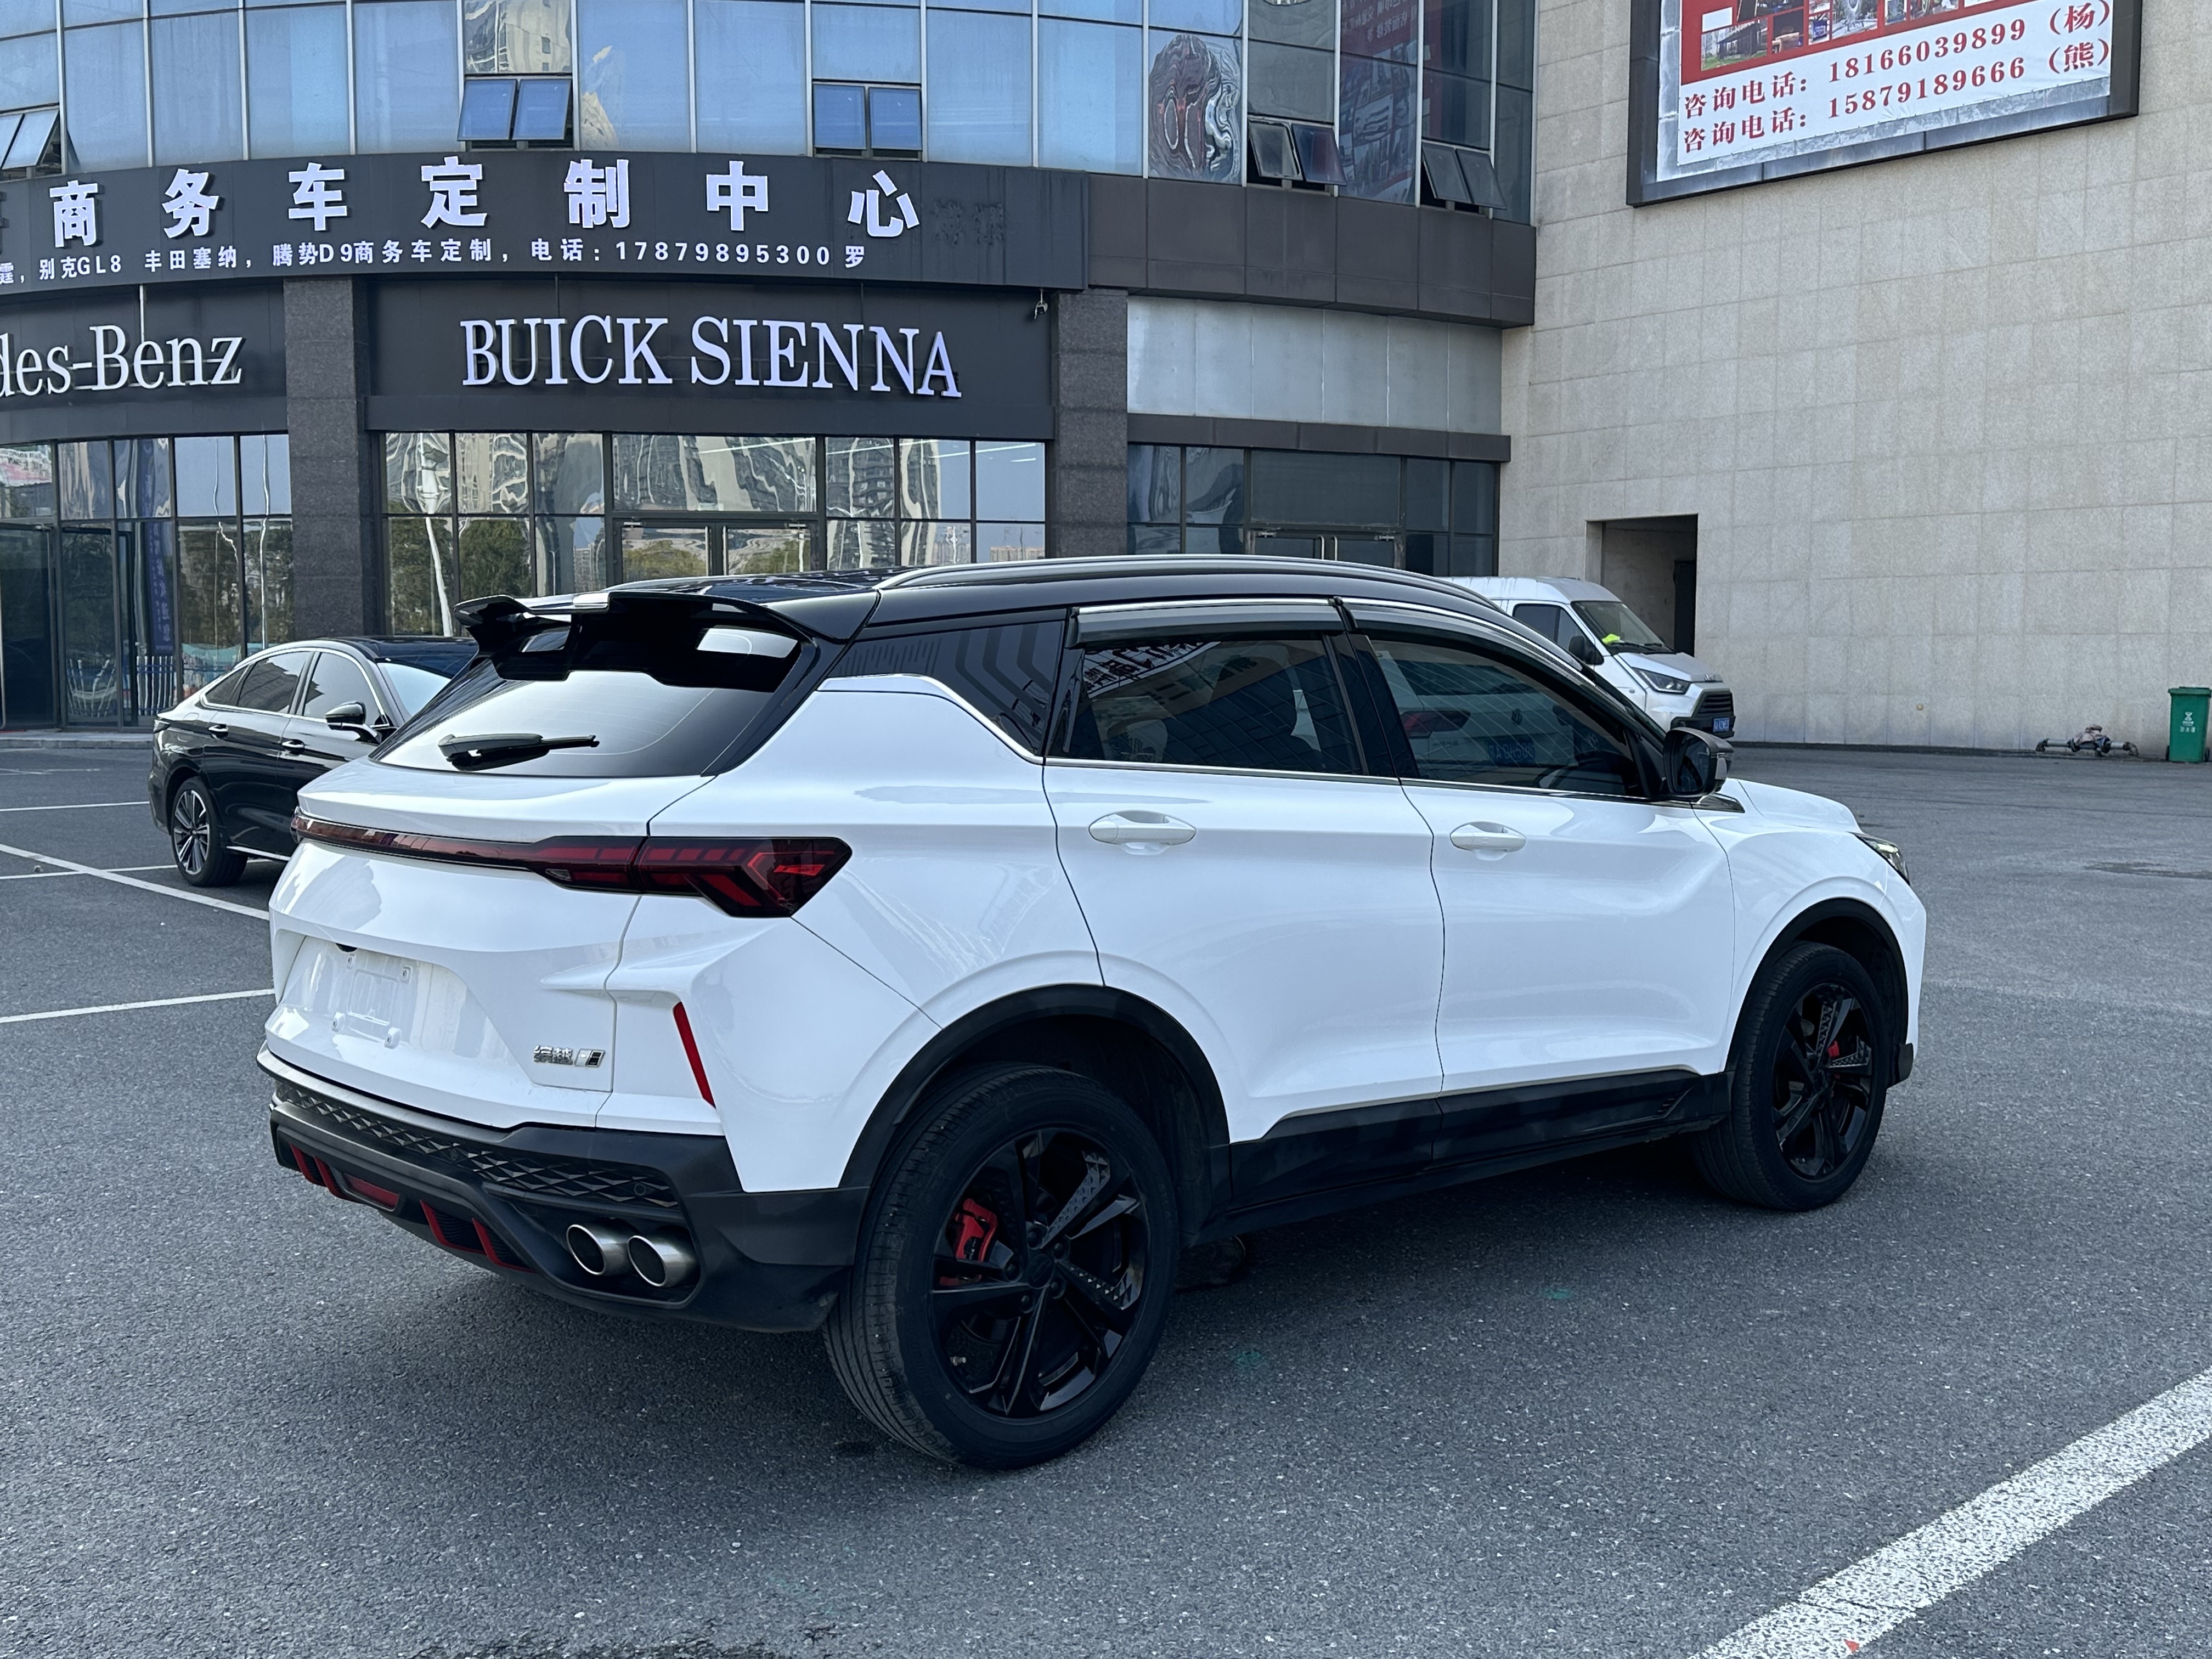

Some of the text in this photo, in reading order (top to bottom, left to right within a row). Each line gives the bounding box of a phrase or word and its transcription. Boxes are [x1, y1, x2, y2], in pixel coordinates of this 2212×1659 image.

[50, 156, 919, 247] 商务车定制中心
[460, 314, 962, 397] BUICK SIENNA
